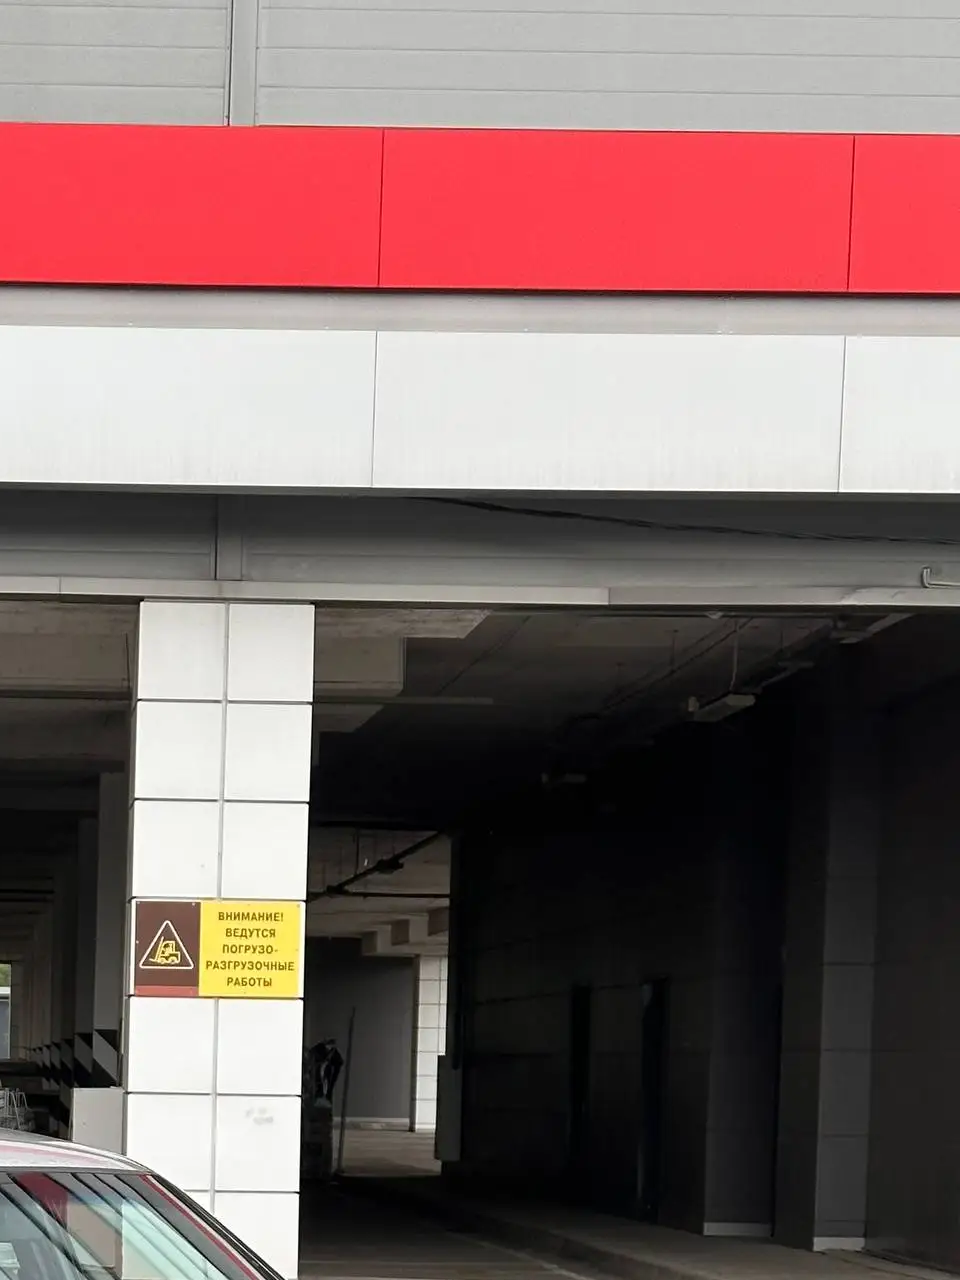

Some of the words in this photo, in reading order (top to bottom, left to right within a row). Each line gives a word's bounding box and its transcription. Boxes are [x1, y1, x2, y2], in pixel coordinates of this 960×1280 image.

[218, 911, 284, 922] ВНИМАНИЕ!
[225, 927, 276, 939] ВЕДУТСЯ
[222, 944, 278, 954] ПОГРУЗО-
[205, 960, 295, 971] РАЗГРУЗОЧНЫЕ
[226, 977, 272, 987] РАБОТЫ
